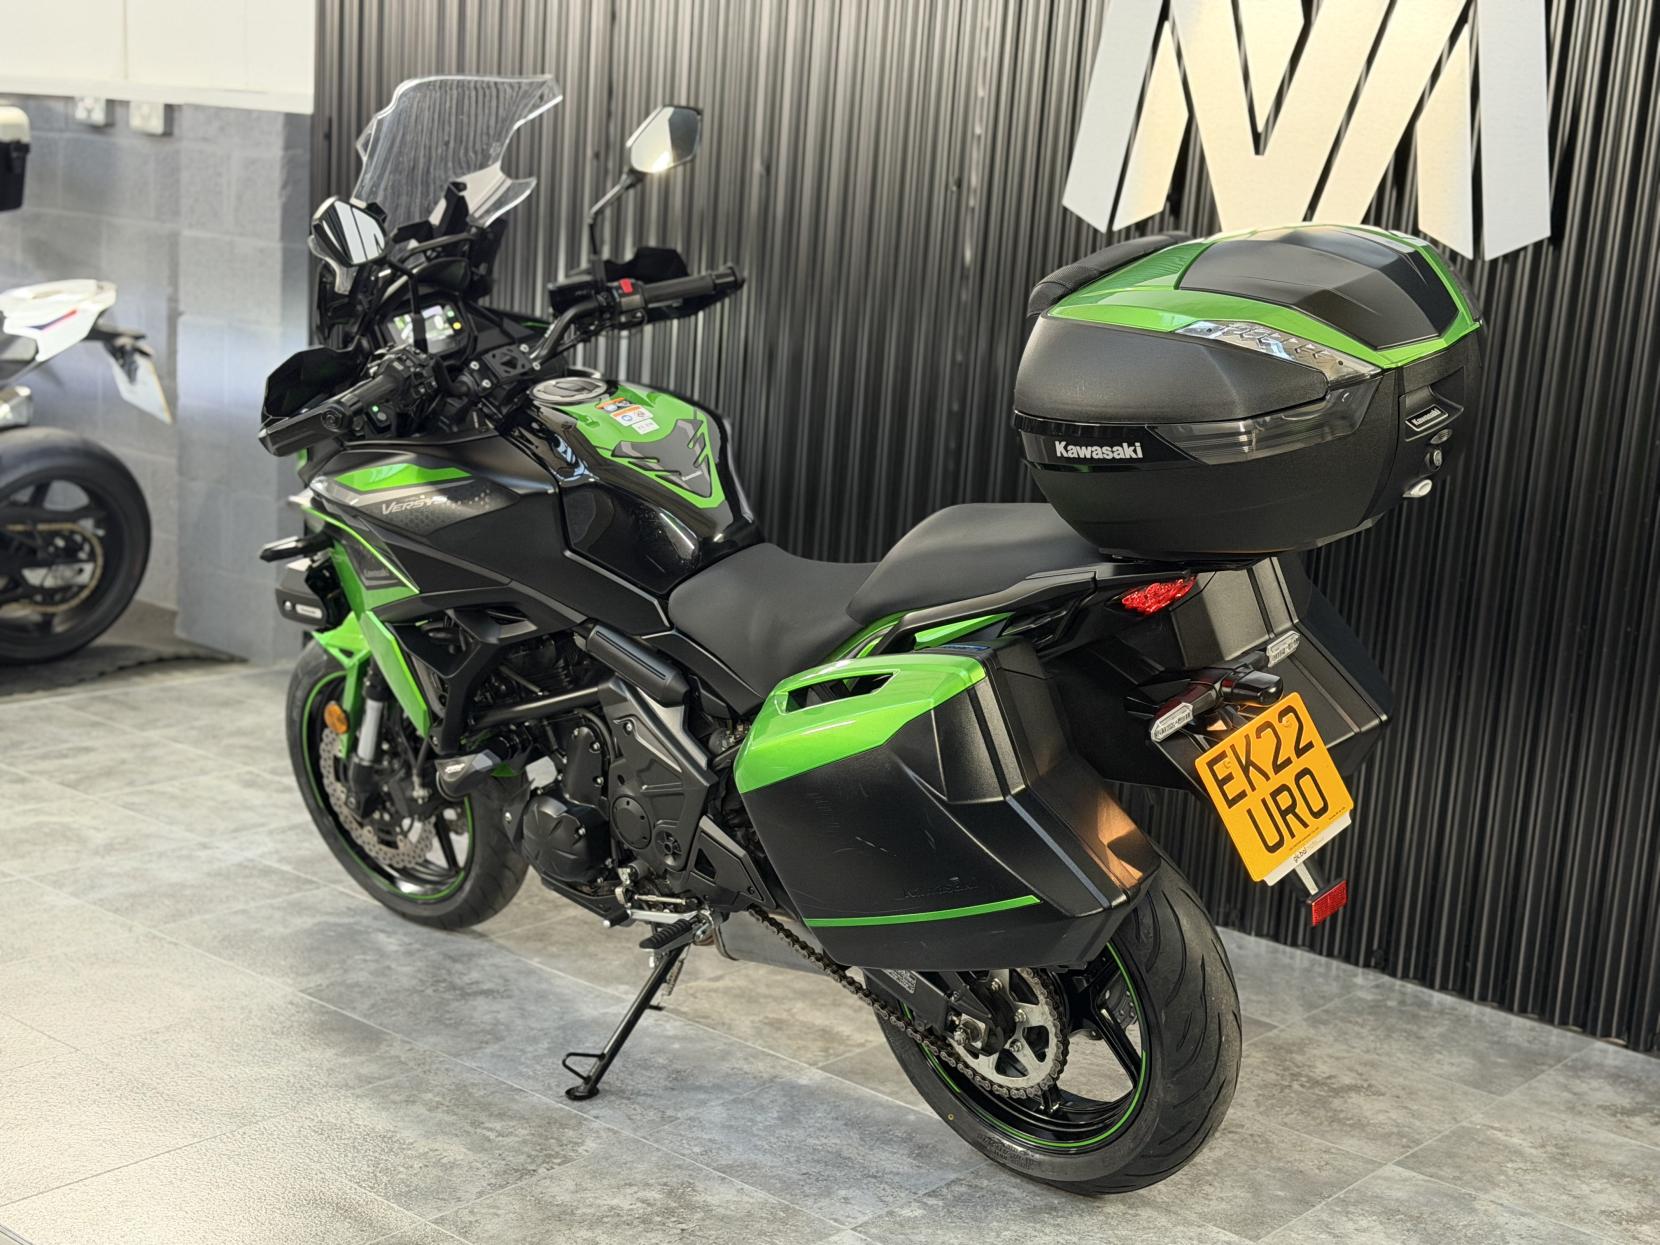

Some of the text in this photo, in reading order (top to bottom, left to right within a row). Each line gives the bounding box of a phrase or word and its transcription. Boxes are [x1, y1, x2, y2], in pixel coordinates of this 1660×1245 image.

[1054, 440, 1144, 460] Kawasaki
[1206, 705, 1315, 809] EK22
[1246, 767, 1329, 854] URO
